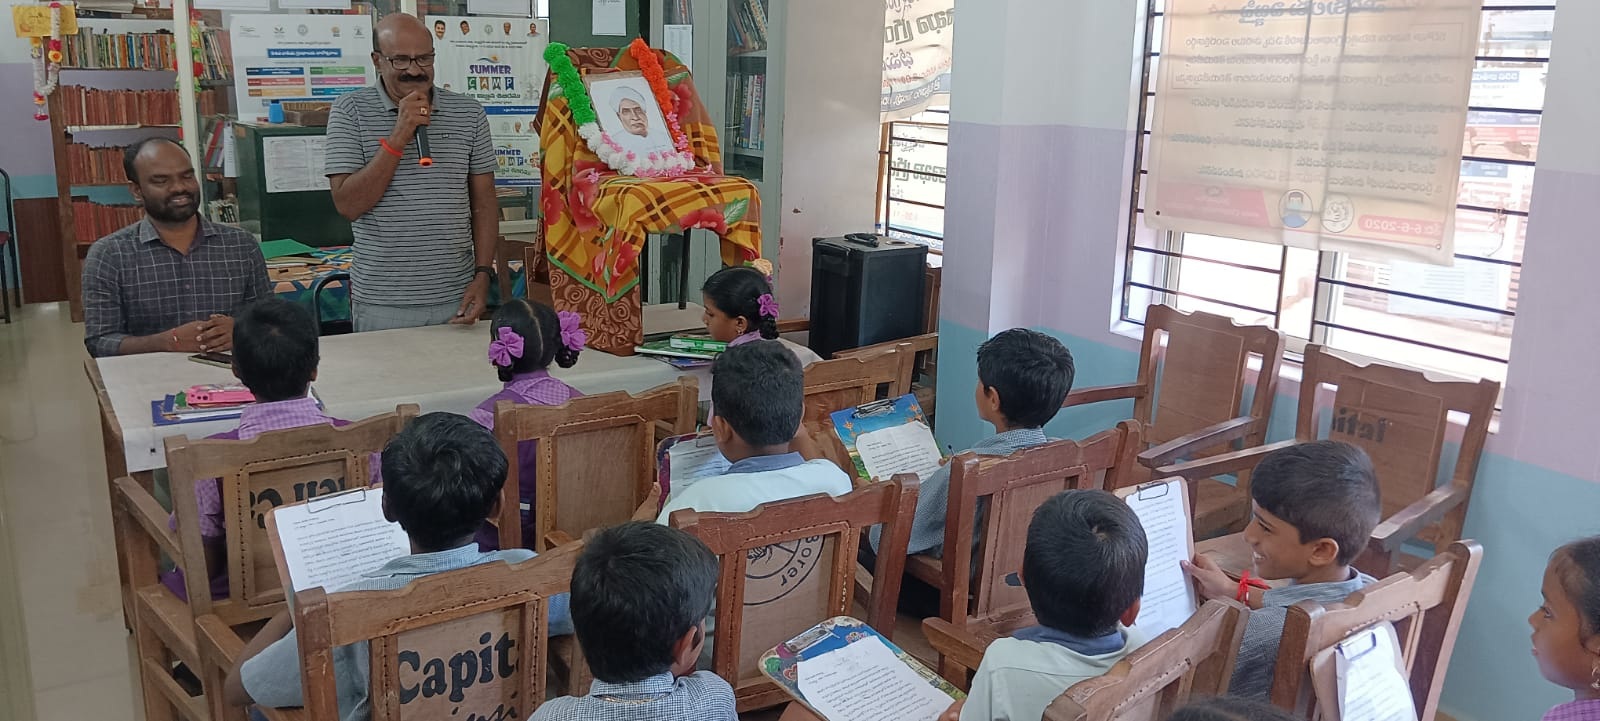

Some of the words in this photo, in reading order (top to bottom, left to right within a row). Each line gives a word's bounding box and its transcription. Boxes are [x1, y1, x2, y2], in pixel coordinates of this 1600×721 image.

[469, 65, 511, 74] SUMMER
[468, 77, 513, 89] CAMP
[1332, 407, 1387, 442] ital
[398, 632, 519, 704] Capit
